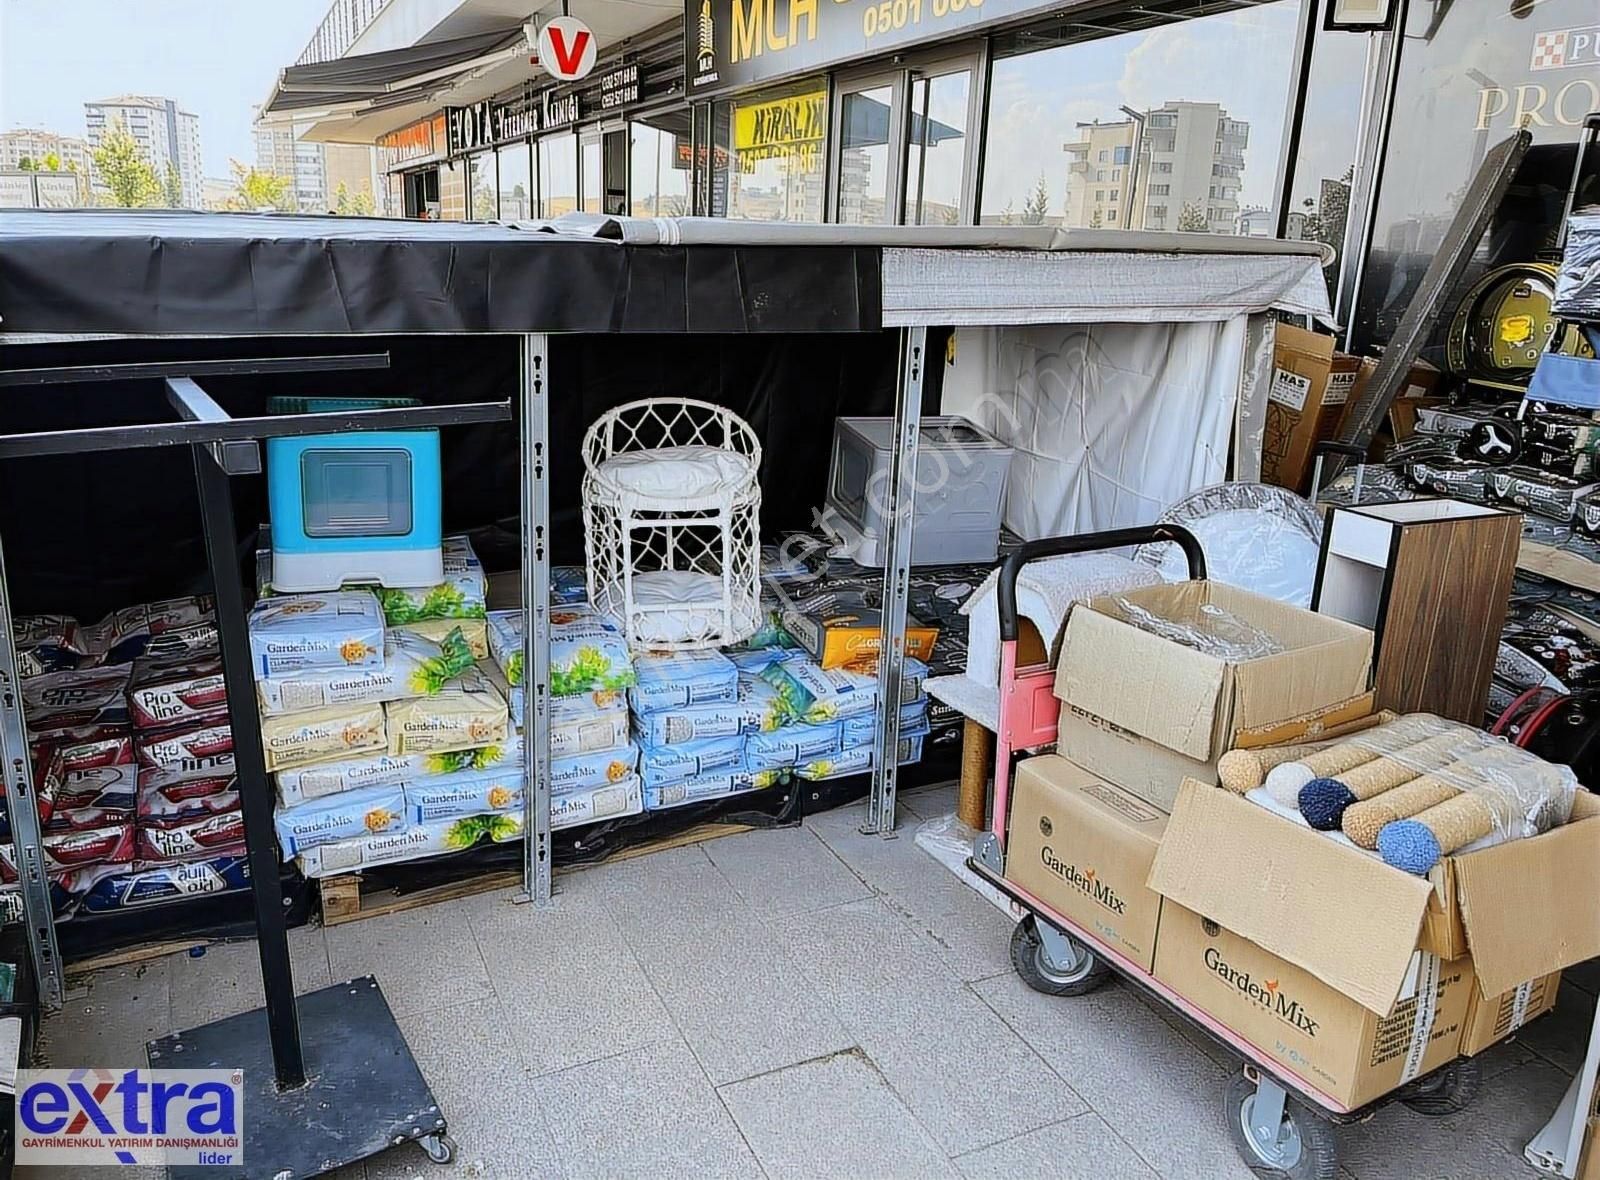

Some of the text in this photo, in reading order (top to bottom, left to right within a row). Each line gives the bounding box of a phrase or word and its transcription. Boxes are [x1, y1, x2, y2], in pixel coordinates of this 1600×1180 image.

[729, 0, 823, 63] MCH
[548, 27, 590, 74] V
[142, 691, 171, 707] Pro
[152, 704, 183, 719] line
[550, 770, 579, 781] arden
[293, 818, 332, 834] Garden
[368, 835, 407, 850] Garden
[1041, 846, 1124, 914] Garden Mix
[1204, 947, 1272, 1008] Garden
[1275, 991, 1320, 1037] Mix
